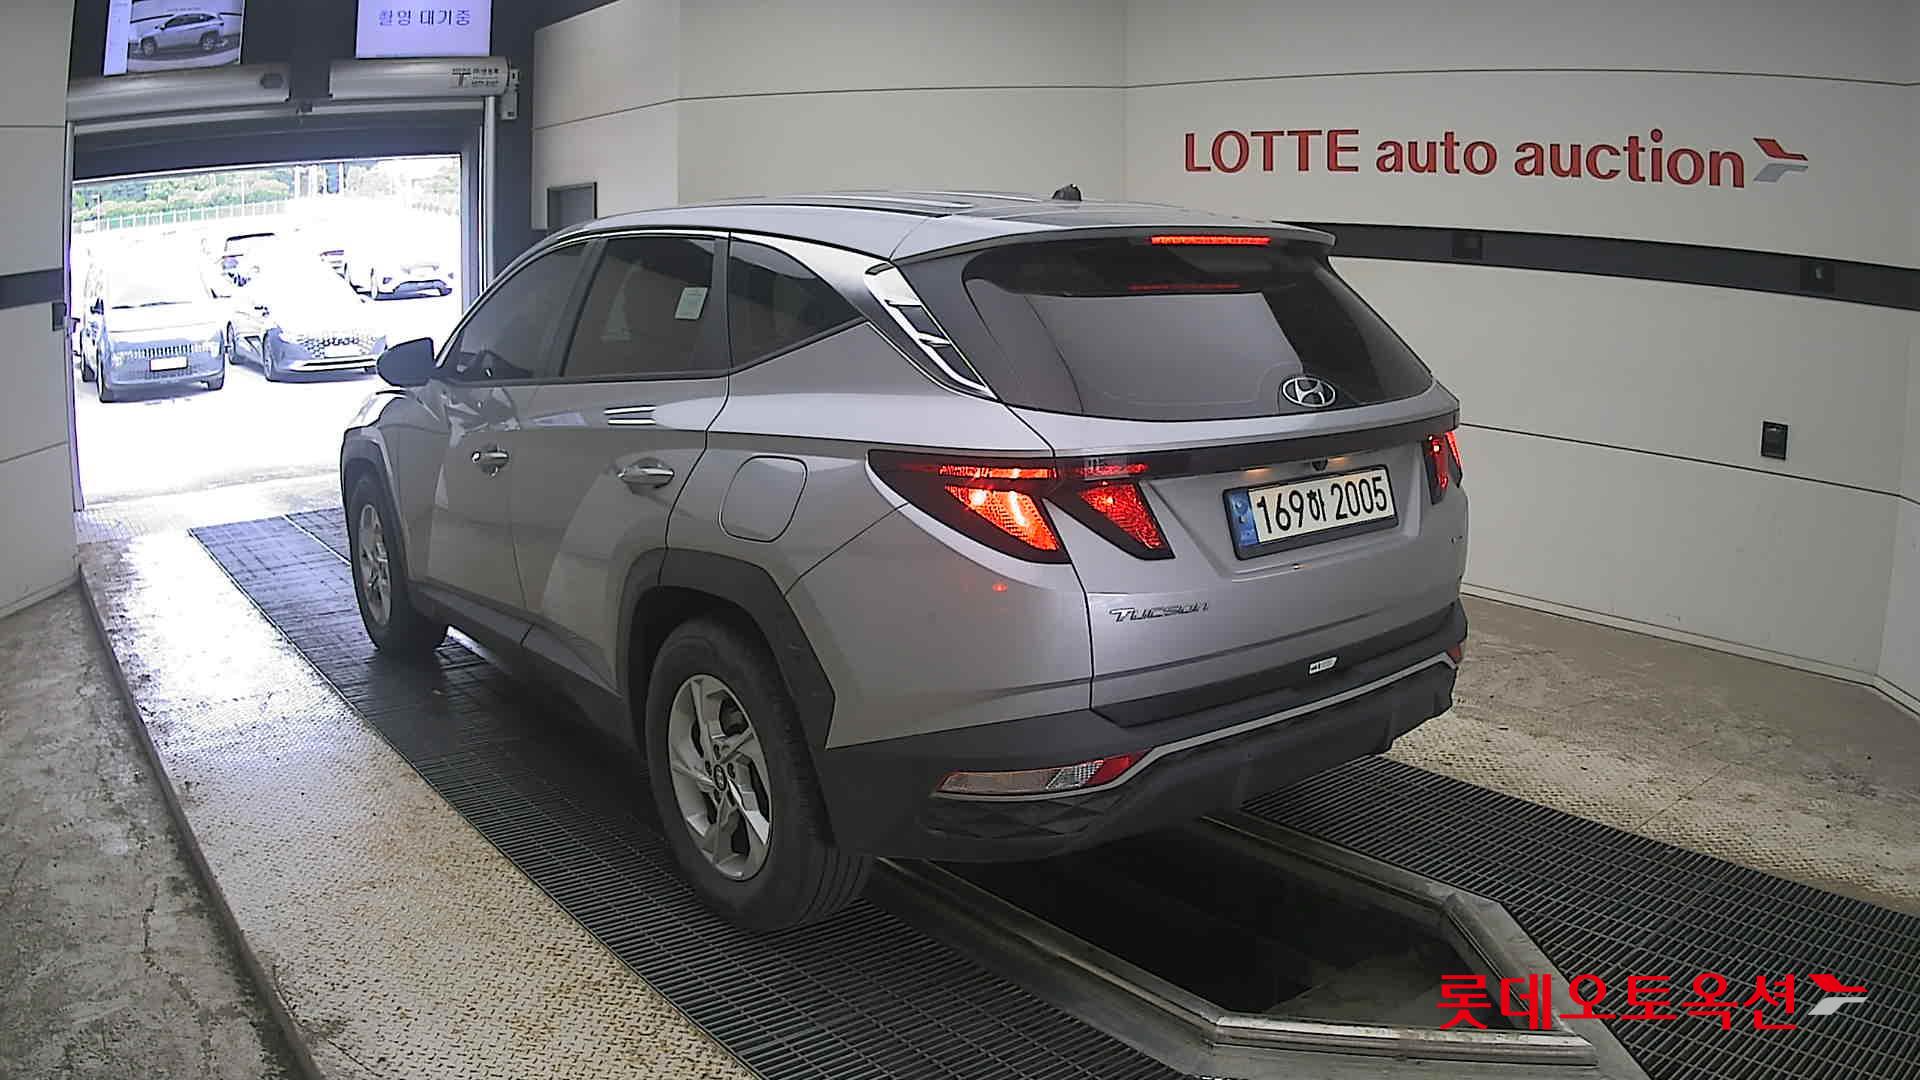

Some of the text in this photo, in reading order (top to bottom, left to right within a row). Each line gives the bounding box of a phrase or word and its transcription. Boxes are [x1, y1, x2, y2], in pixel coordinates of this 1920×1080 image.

[419, 9, 471, 27] 대기중
[1184, 128, 1745, 189] LOTTE auto auction
[1256, 488, 1327, 535] 169하
[1330, 476, 1388, 521] 2005
